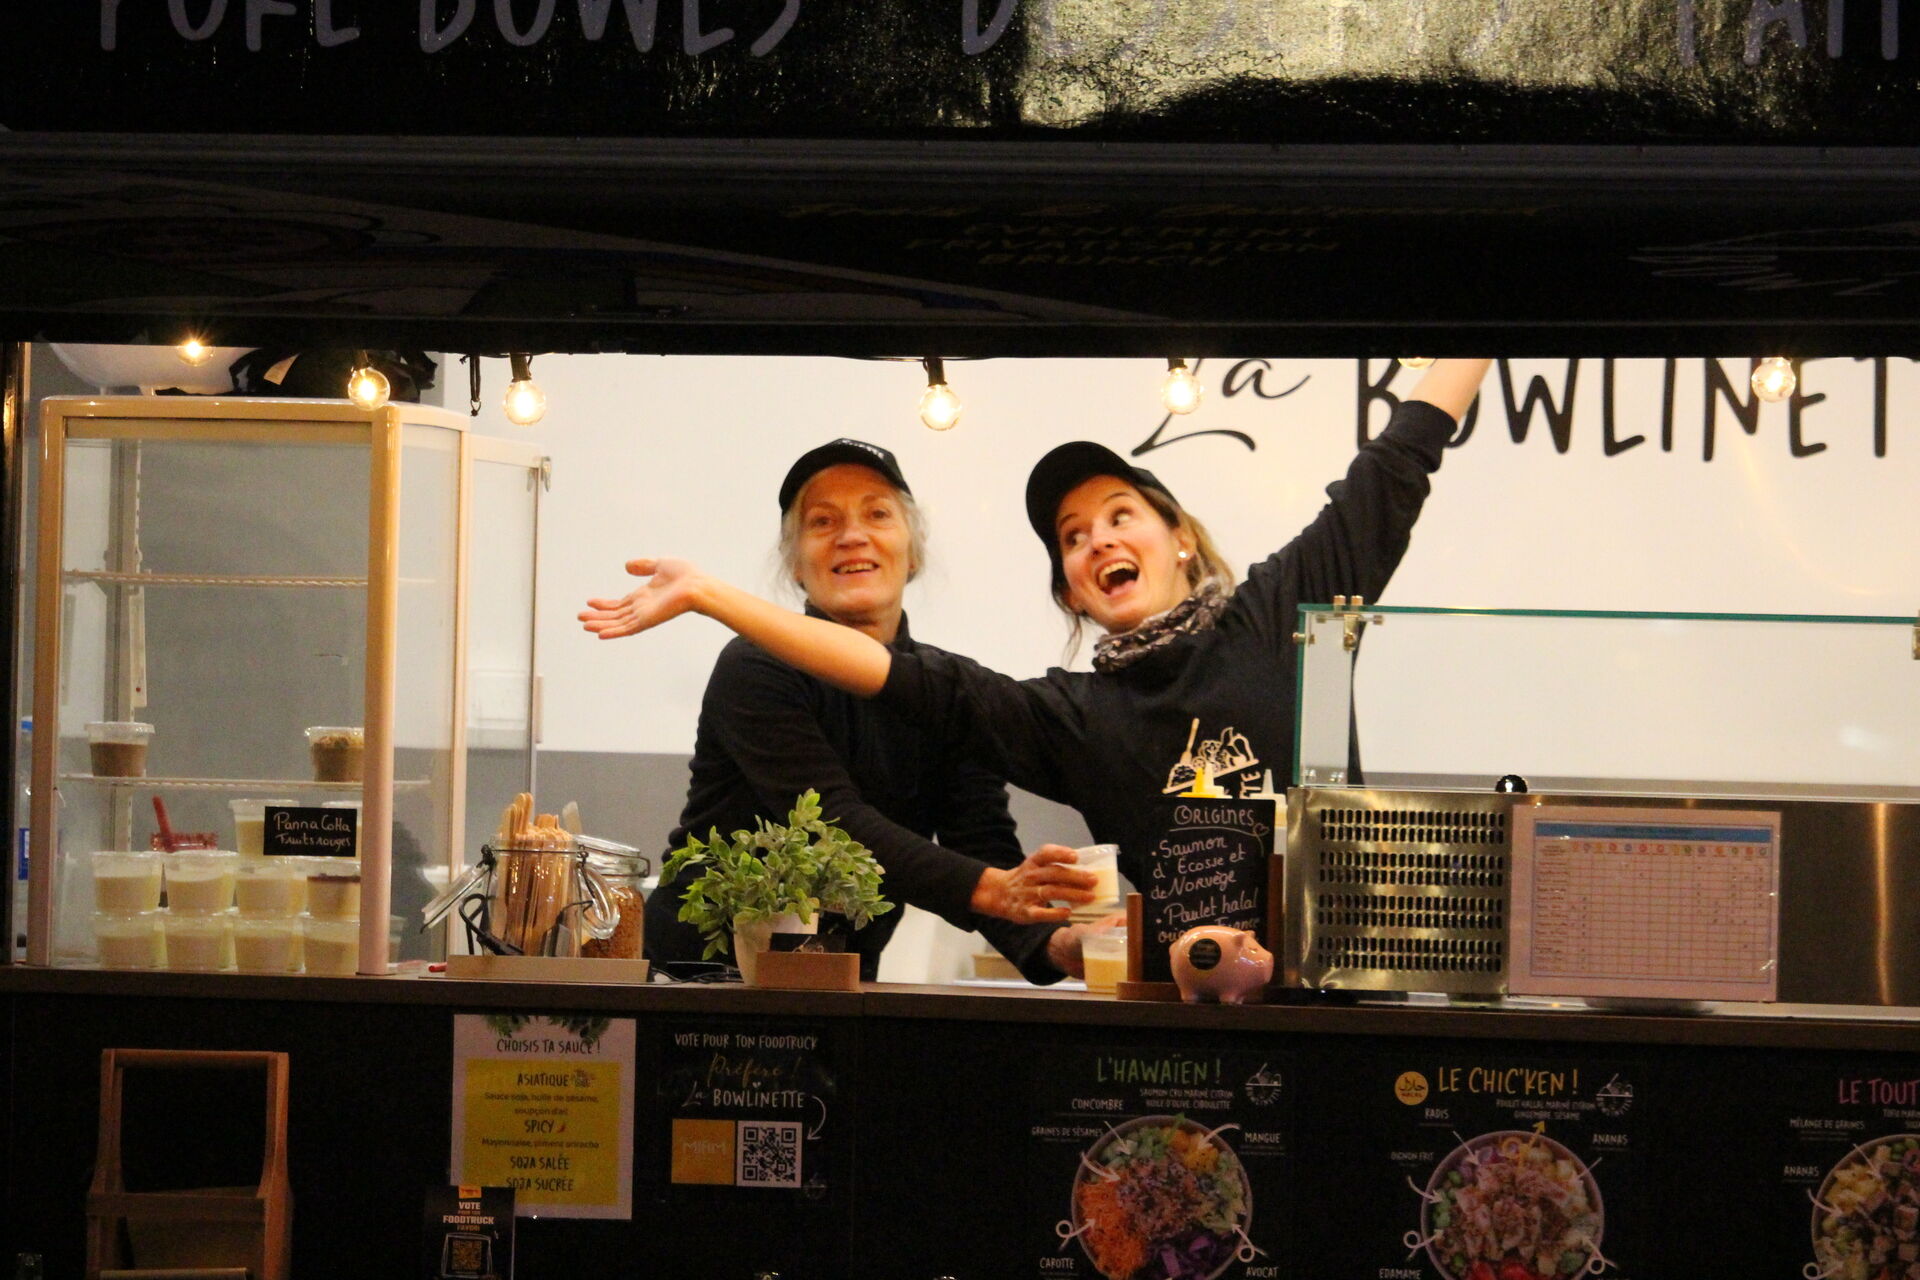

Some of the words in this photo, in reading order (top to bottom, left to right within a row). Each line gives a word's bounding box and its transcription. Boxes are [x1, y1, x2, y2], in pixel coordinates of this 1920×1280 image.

[273, 811, 319, 831] Panna
[1159, 836, 1228, 859] Saumon
[1229, 843, 1246, 863] et
[1151, 885, 1168, 900] de
[1164, 896, 1217, 925] Poulet
[1222, 888, 1259, 915] halal
[496, 1038, 539, 1052] CHOISIS
[543, 1039, 555, 1053] TA
[558, 1040, 592, 1055] SAUCE
[674, 1032, 699, 1047] VOTE
[703, 1033, 729, 1049] POUR
[736, 1034, 755, 1049] TON
[759, 1034, 818, 1050] FOODTRUCK
[1096, 1053, 1208, 1085] L'HAWAÏEN
[517, 1072, 569, 1087] ASIATIQUE
[1439, 1066, 1462, 1093] LE
[681, 1081, 707, 1108] La
[713, 1088, 806, 1109] BOWLINETTE
[1838, 1079, 1862, 1104] LE
[1071, 1098, 1125, 1111] CONCOMBRE
[1425, 1108, 1449, 1120] RADIS
[524, 1119, 555, 1133] SPICY
[1244, 1132, 1281, 1144] MANGUE
[1592, 1133, 1629, 1145] ANANAS
[509, 1156, 536, 1170] SOJA
[540, 1154, 570, 1170] SALÉE
[1783, 1165, 1820, 1177] ANANAS
[505, 1176, 533, 1191] SOJA
[535, 1176, 574, 1192] SUCRÉE
[458, 1201, 481, 1210] VOTE
[442, 1214, 495, 1225] FOODTRUCK
[1039, 1257, 1075, 1270] CAROTTE
[1246, 1266, 1279, 1279] AVOCAT
